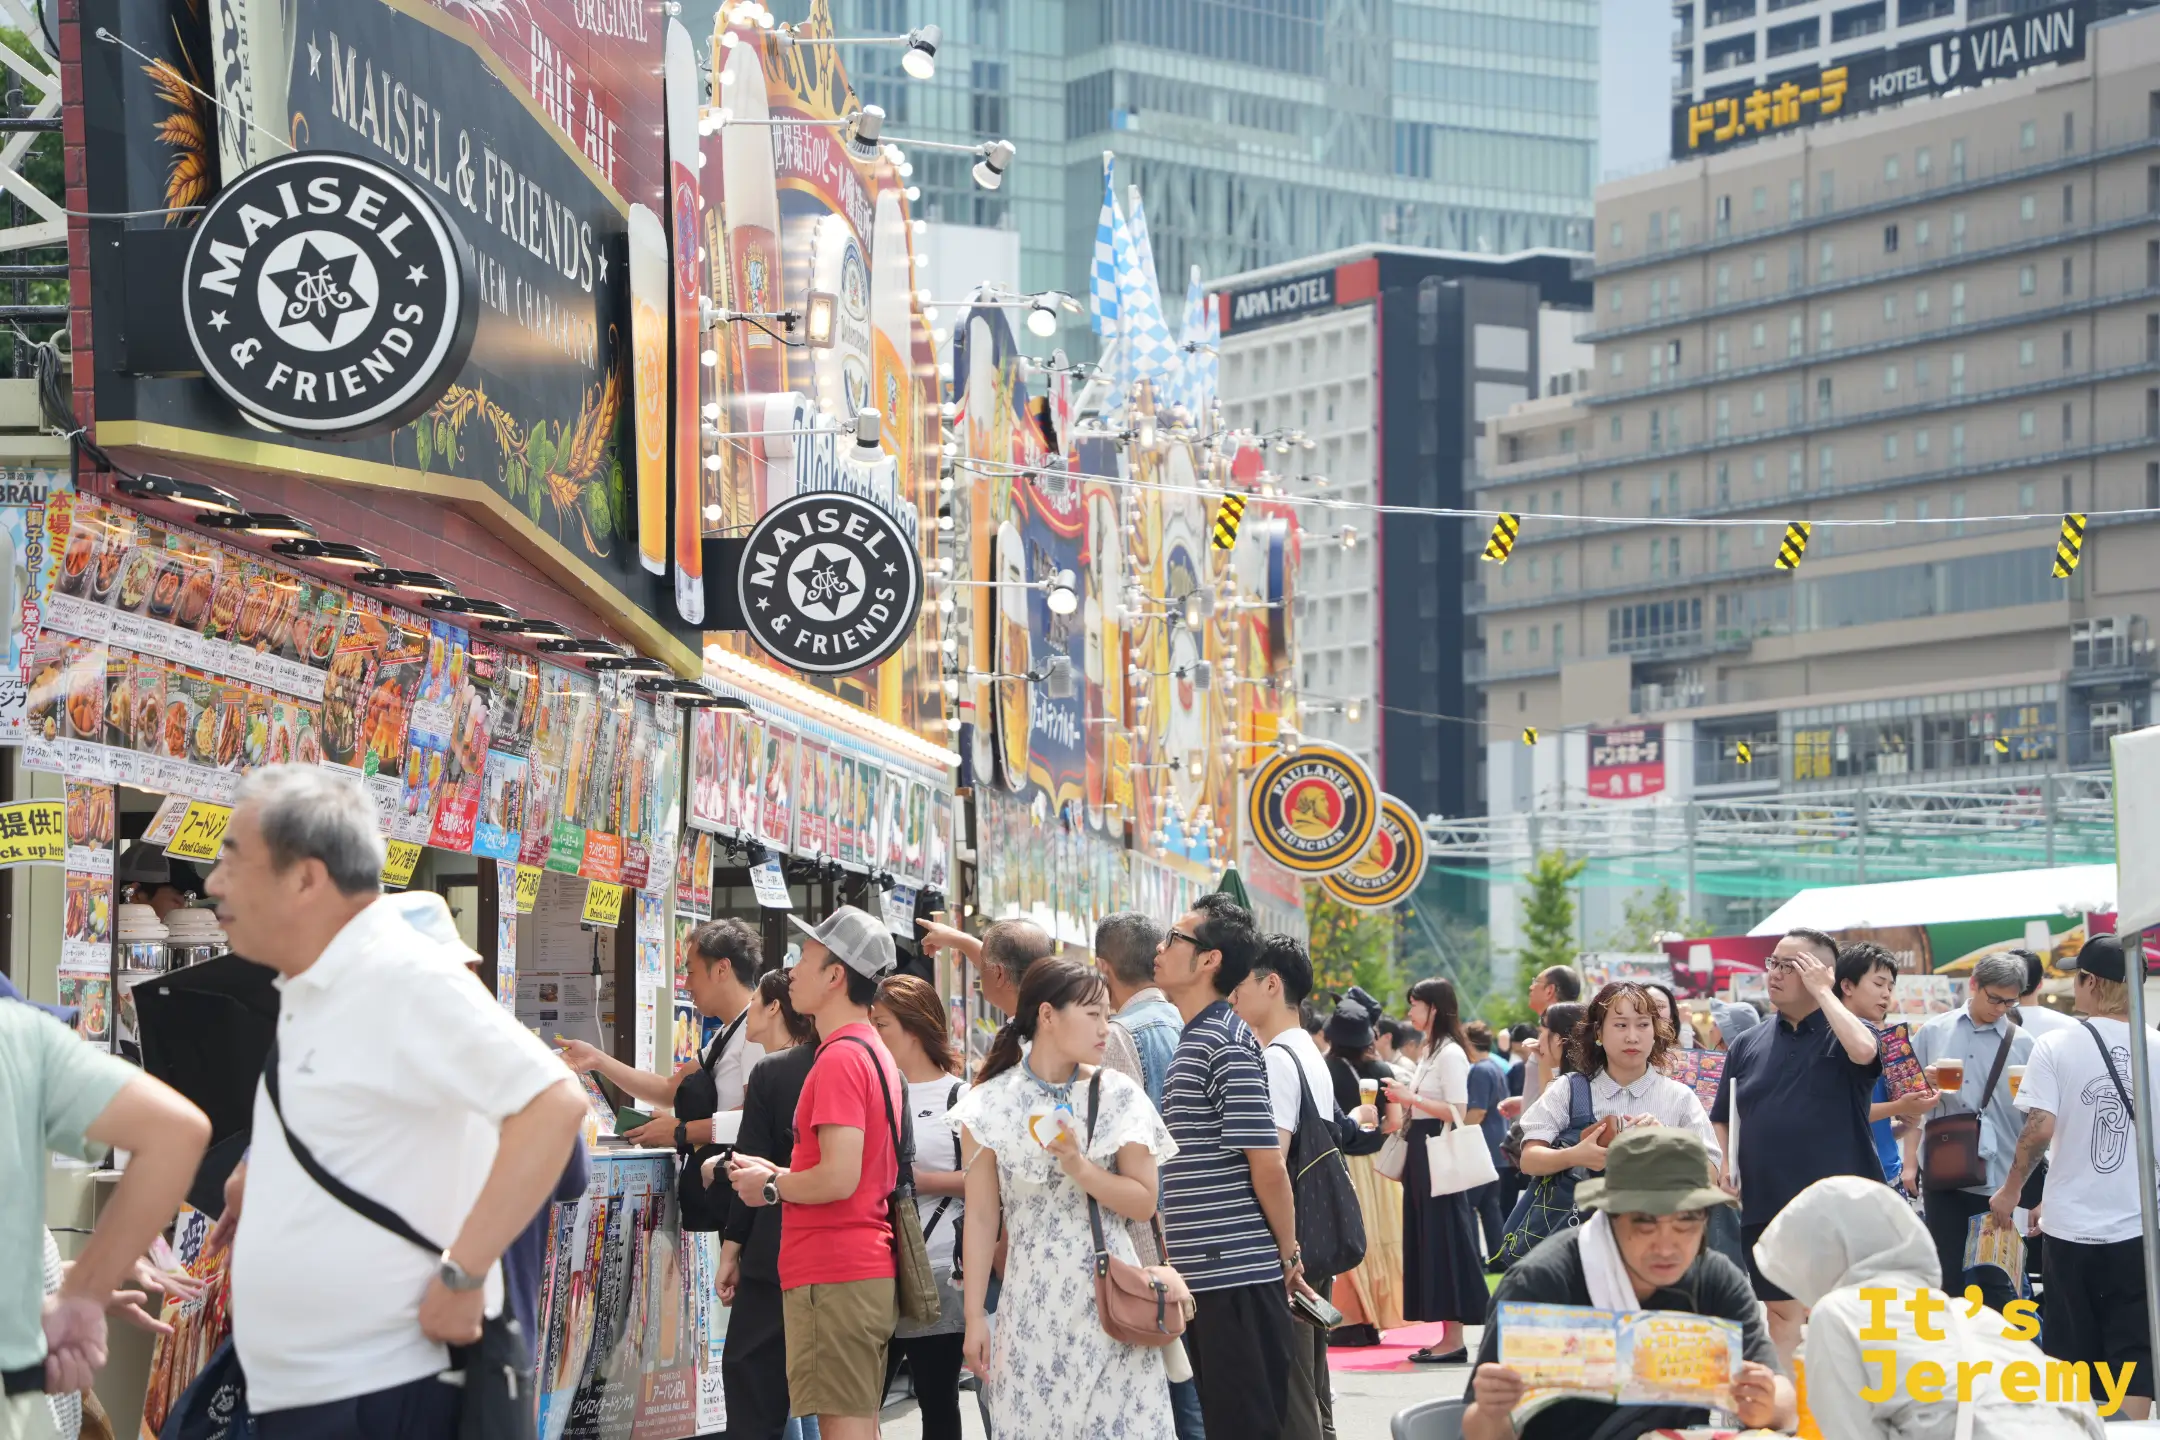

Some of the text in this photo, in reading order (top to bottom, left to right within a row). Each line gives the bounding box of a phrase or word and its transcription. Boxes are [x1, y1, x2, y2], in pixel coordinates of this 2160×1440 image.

[1970, 8, 2074, 72] VIA INN
[1869, 65, 1928, 99] HOTEL
[530, 20, 617, 185] PALE ALE
[329, 31, 593, 293] MAISEL & FRIENDS
[199, 177, 413, 298] MAISEL
[1235, 277, 1330, 320] APA HOTEL
[516, 276, 596, 371] CHARAKTER
[230, 302, 424, 403] & FRIENDS
[750, 508, 887, 589] MAISEL
[352, 591, 383, 618] BEEF STEAK
[391, 604, 429, 633] CURRY WURST
[771, 587, 896, 655] & FRIENDS
[1273, 764, 1354, 800] PAULANER
[0, 808, 62, 839] 提供口
[184, 810, 230, 841] フードレジ
[28, 845, 47, 858] up
[49, 843, 64, 856] here
[178, 839, 214, 855] Food Cashier
[589, 908, 603, 919] Drink
